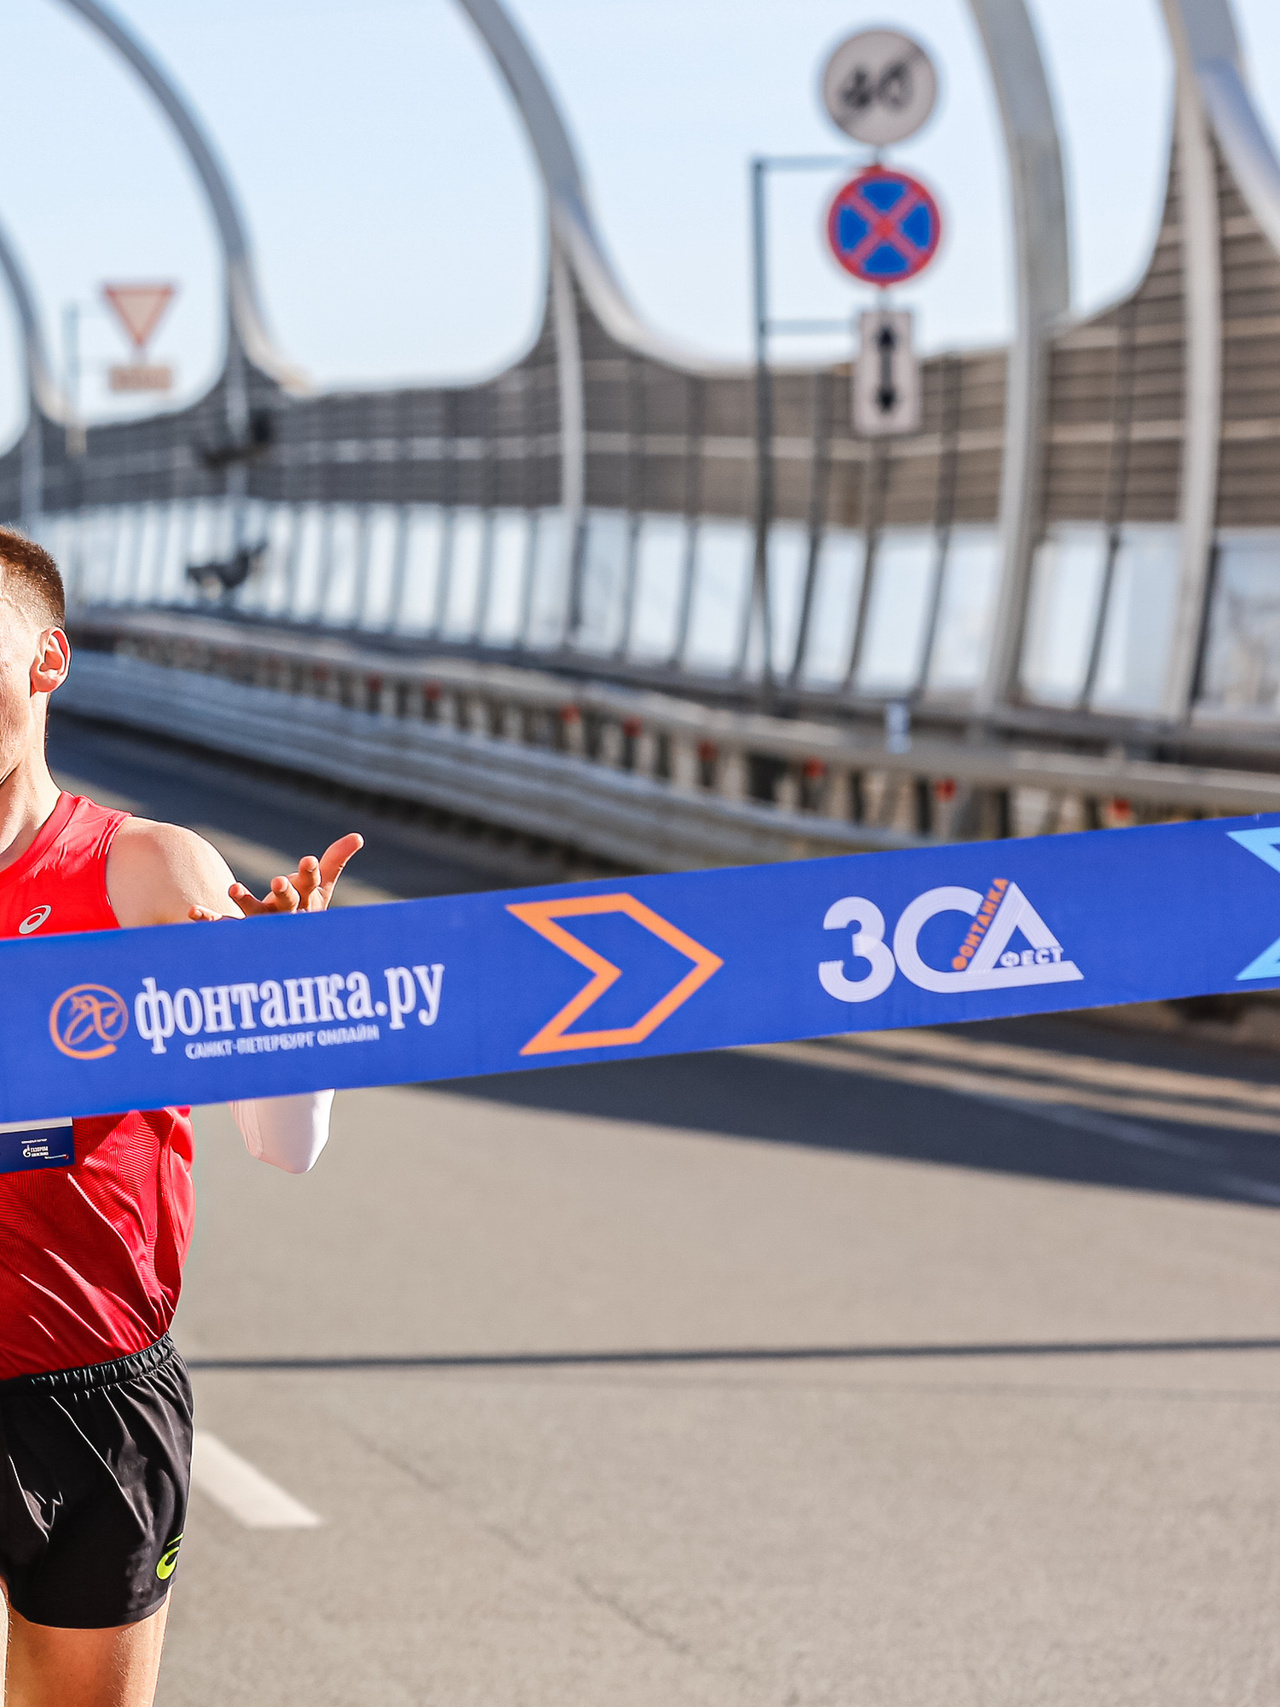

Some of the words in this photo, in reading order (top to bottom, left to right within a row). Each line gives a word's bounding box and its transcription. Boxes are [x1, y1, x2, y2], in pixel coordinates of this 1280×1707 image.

[134, 963, 445, 1054] фонтанка.ру
[185, 1031, 315, 1060] САНКТ-ПЕТЕРБУРГ
[317, 1023, 380, 1046] ОНЛАЙН
